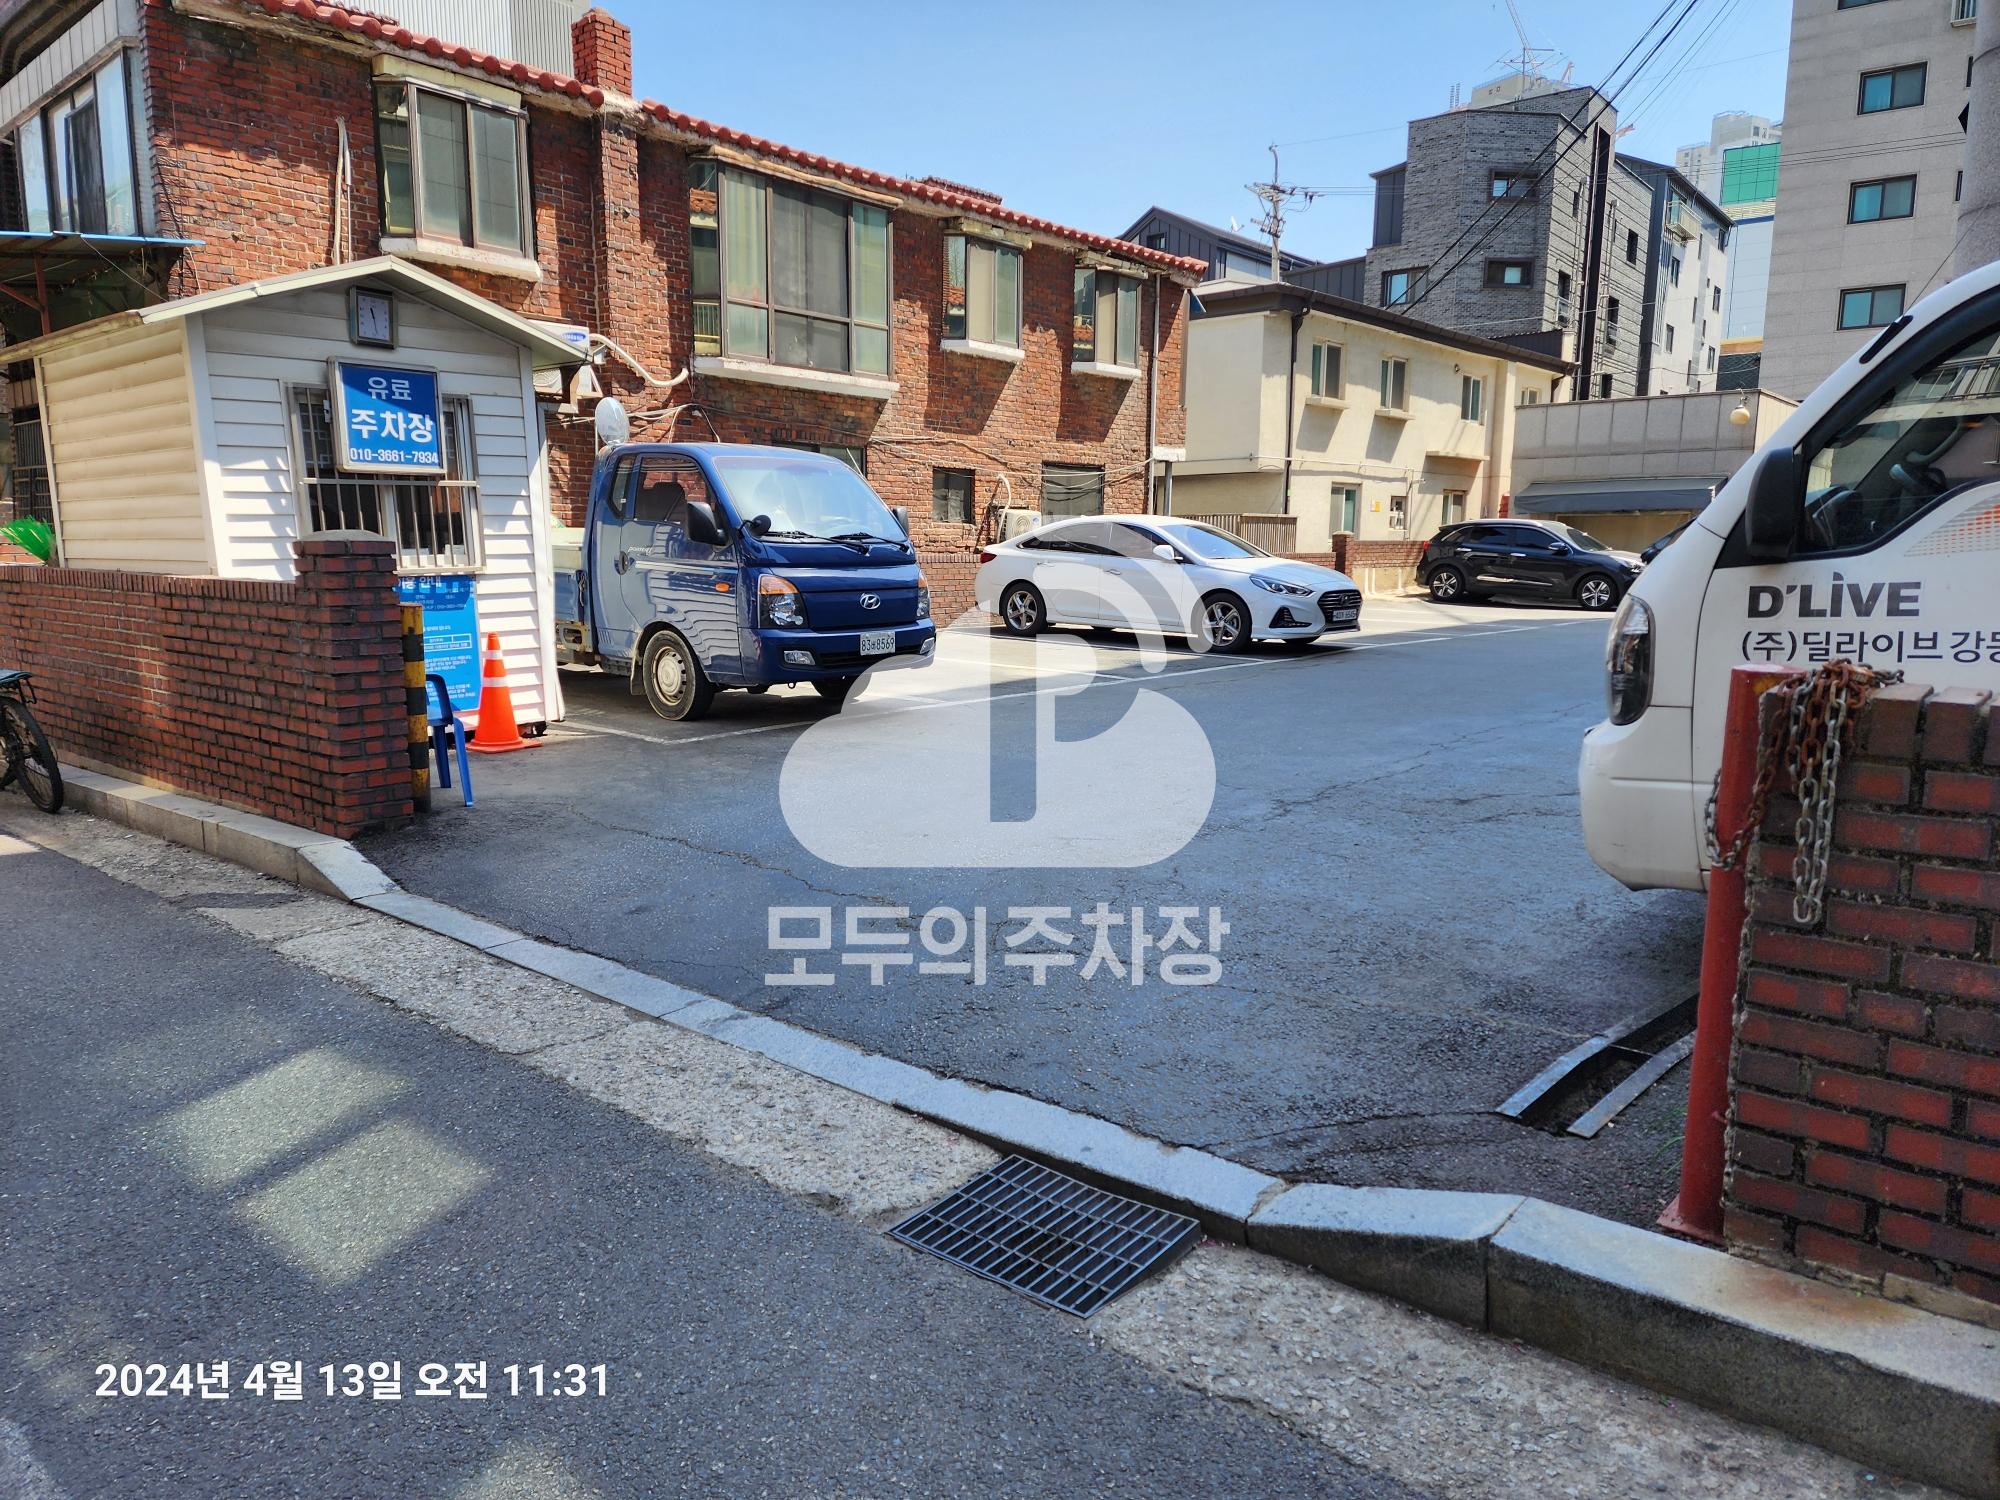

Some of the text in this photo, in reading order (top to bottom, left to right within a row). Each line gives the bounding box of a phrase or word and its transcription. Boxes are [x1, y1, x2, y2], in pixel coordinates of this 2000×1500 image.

[368, 377, 412, 400] 유료
[352, 409, 435, 443] 주차장
[350, 448, 439, 464] 010-3661-7934
[1742, 631, 1943, 663] (주)딜라이브
